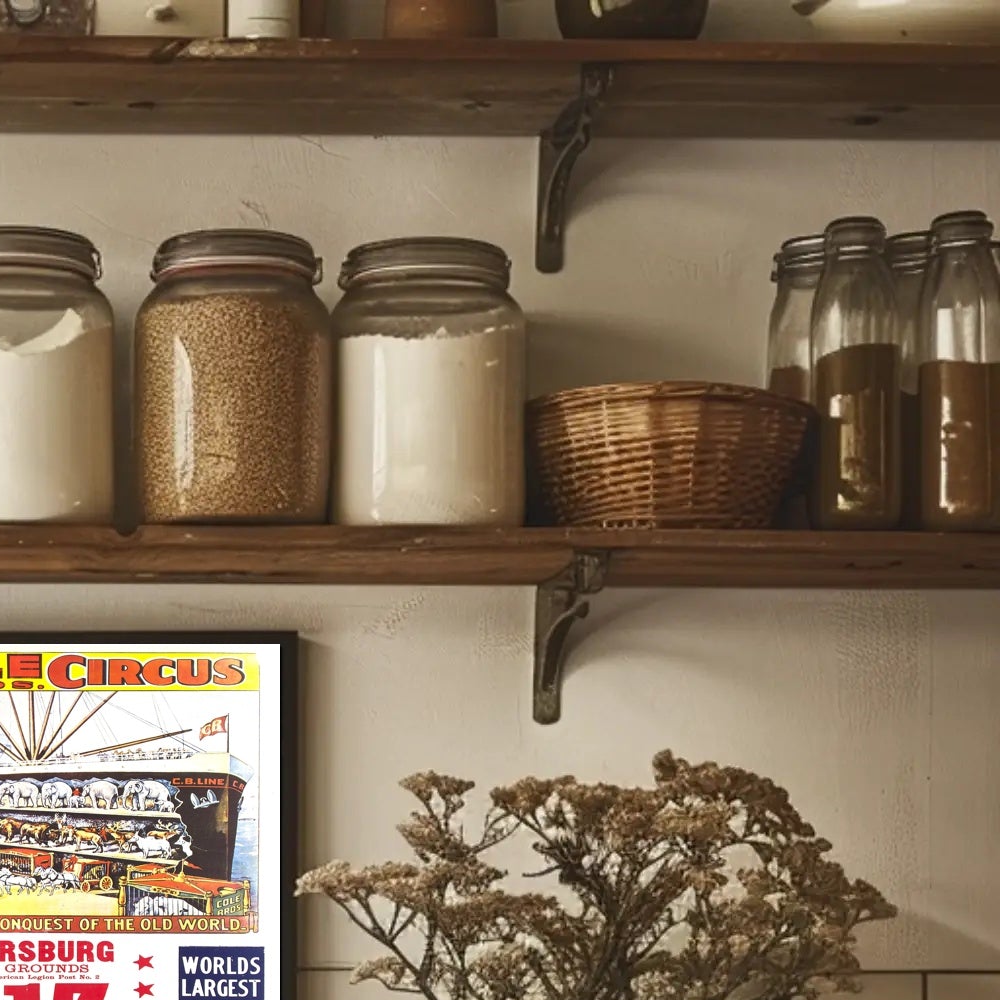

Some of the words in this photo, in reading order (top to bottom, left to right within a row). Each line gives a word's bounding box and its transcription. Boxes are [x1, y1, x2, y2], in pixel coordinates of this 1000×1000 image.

[47, 654, 245, 689] CIRCUS
[216, 894, 240, 909] COLE
[79, 918, 100, 931] OF
[104, 918, 135, 931] THE
[140, 918, 173, 931] OLD
[4, 964, 89, 973] GROUNDS
[182, 956, 261, 975] WORLDS
[181, 978, 261, 997] LARGEST
